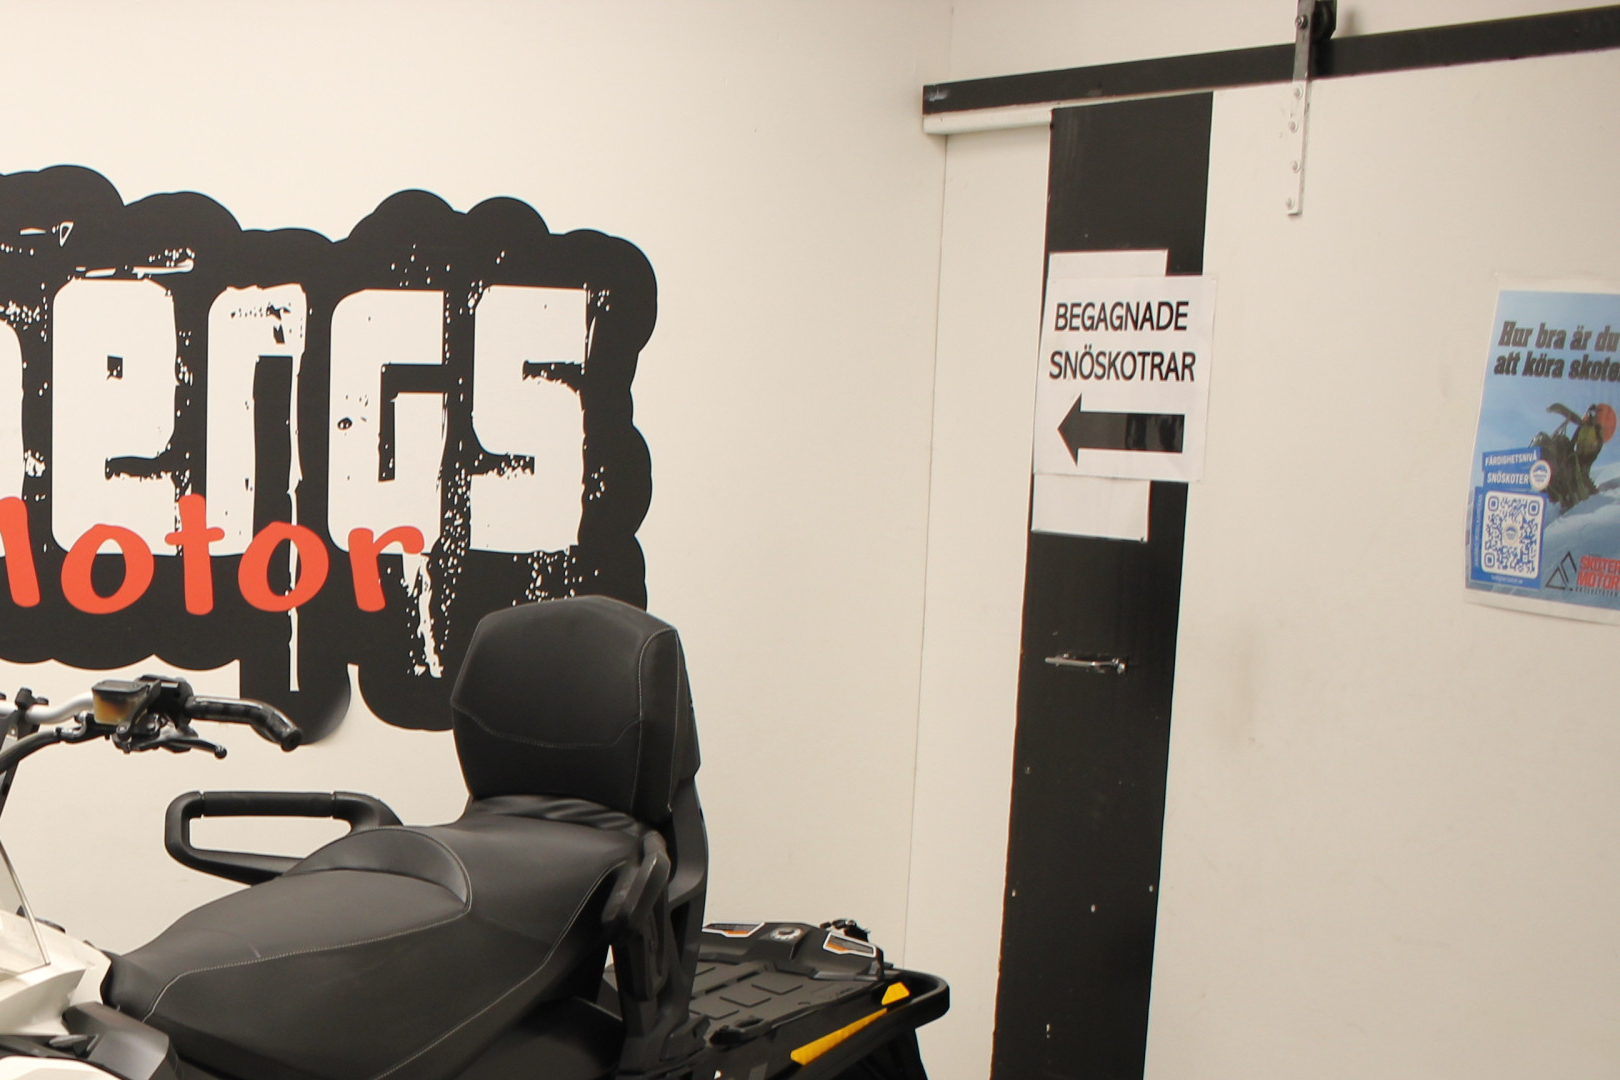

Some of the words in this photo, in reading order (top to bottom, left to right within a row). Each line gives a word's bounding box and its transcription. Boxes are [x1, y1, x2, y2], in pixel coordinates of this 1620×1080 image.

[1054, 301, 1189, 332] BEGAGNADE
[1498, 320, 1533, 347] Hur
[1535, 322, 1567, 349] bra
[1569, 325, 1592, 350] är
[1594, 325, 1620, 352] du
[1049, 344, 1196, 382] SNÖSKOTRAR
[1494, 351, 1521, 376] att
[1522, 351, 1565, 378] köra
[1568, 354, 1620, 382] skote
